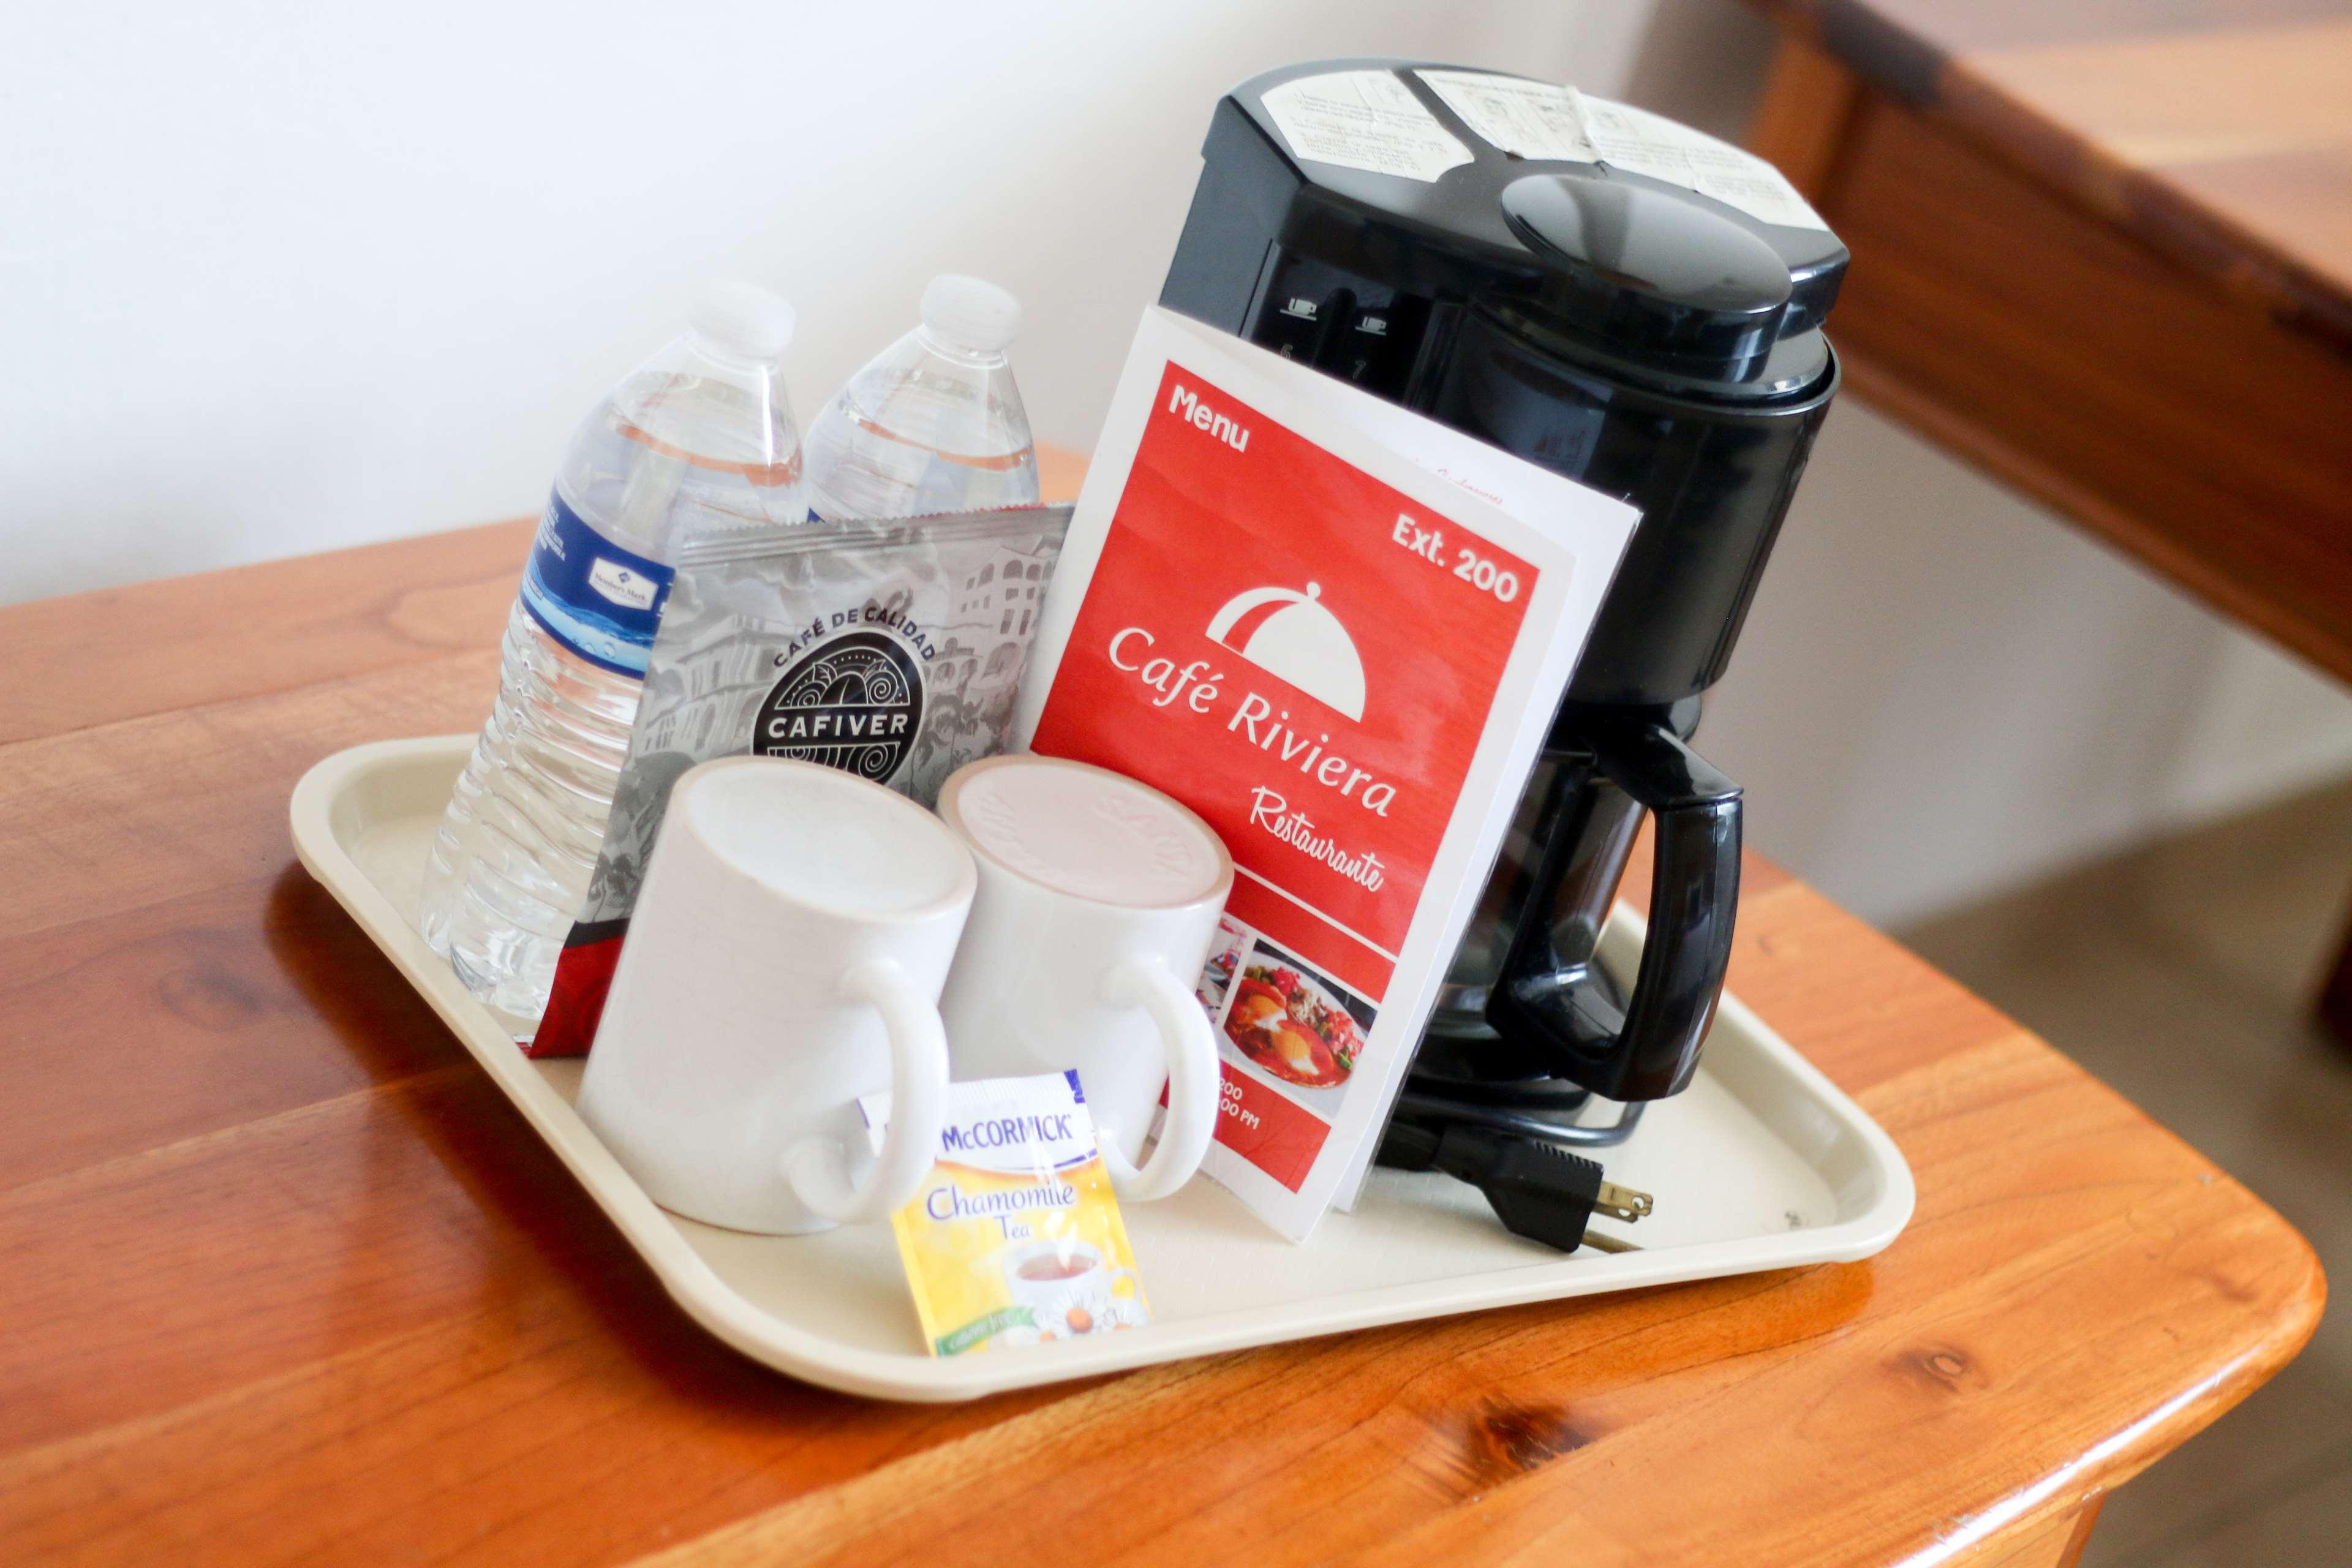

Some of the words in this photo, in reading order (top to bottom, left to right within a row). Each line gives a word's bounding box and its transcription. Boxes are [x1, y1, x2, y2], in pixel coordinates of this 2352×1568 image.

[1168, 384, 1250, 453] Menu
[1392, 513, 1446, 567] Ext.
[1453, 548, 1518, 603] 200
[774, 617, 826, 668] CAFÉ
[832, 608, 859, 628] DE
[864, 607, 936, 662] CALIDAD
[768, 713, 910, 739] CAFIVER
[1109, 627, 1224, 714] Café
[1227, 692, 1398, 818] Riviera
[1249, 785, 1386, 892] Restaurante
[941, 1114, 1072, 1153] McCORMICK
[1240, 1109, 1260, 1130] PM
[927, 1182, 1075, 1221] Chamomile
[994, 1215, 1032, 1240] Tea
